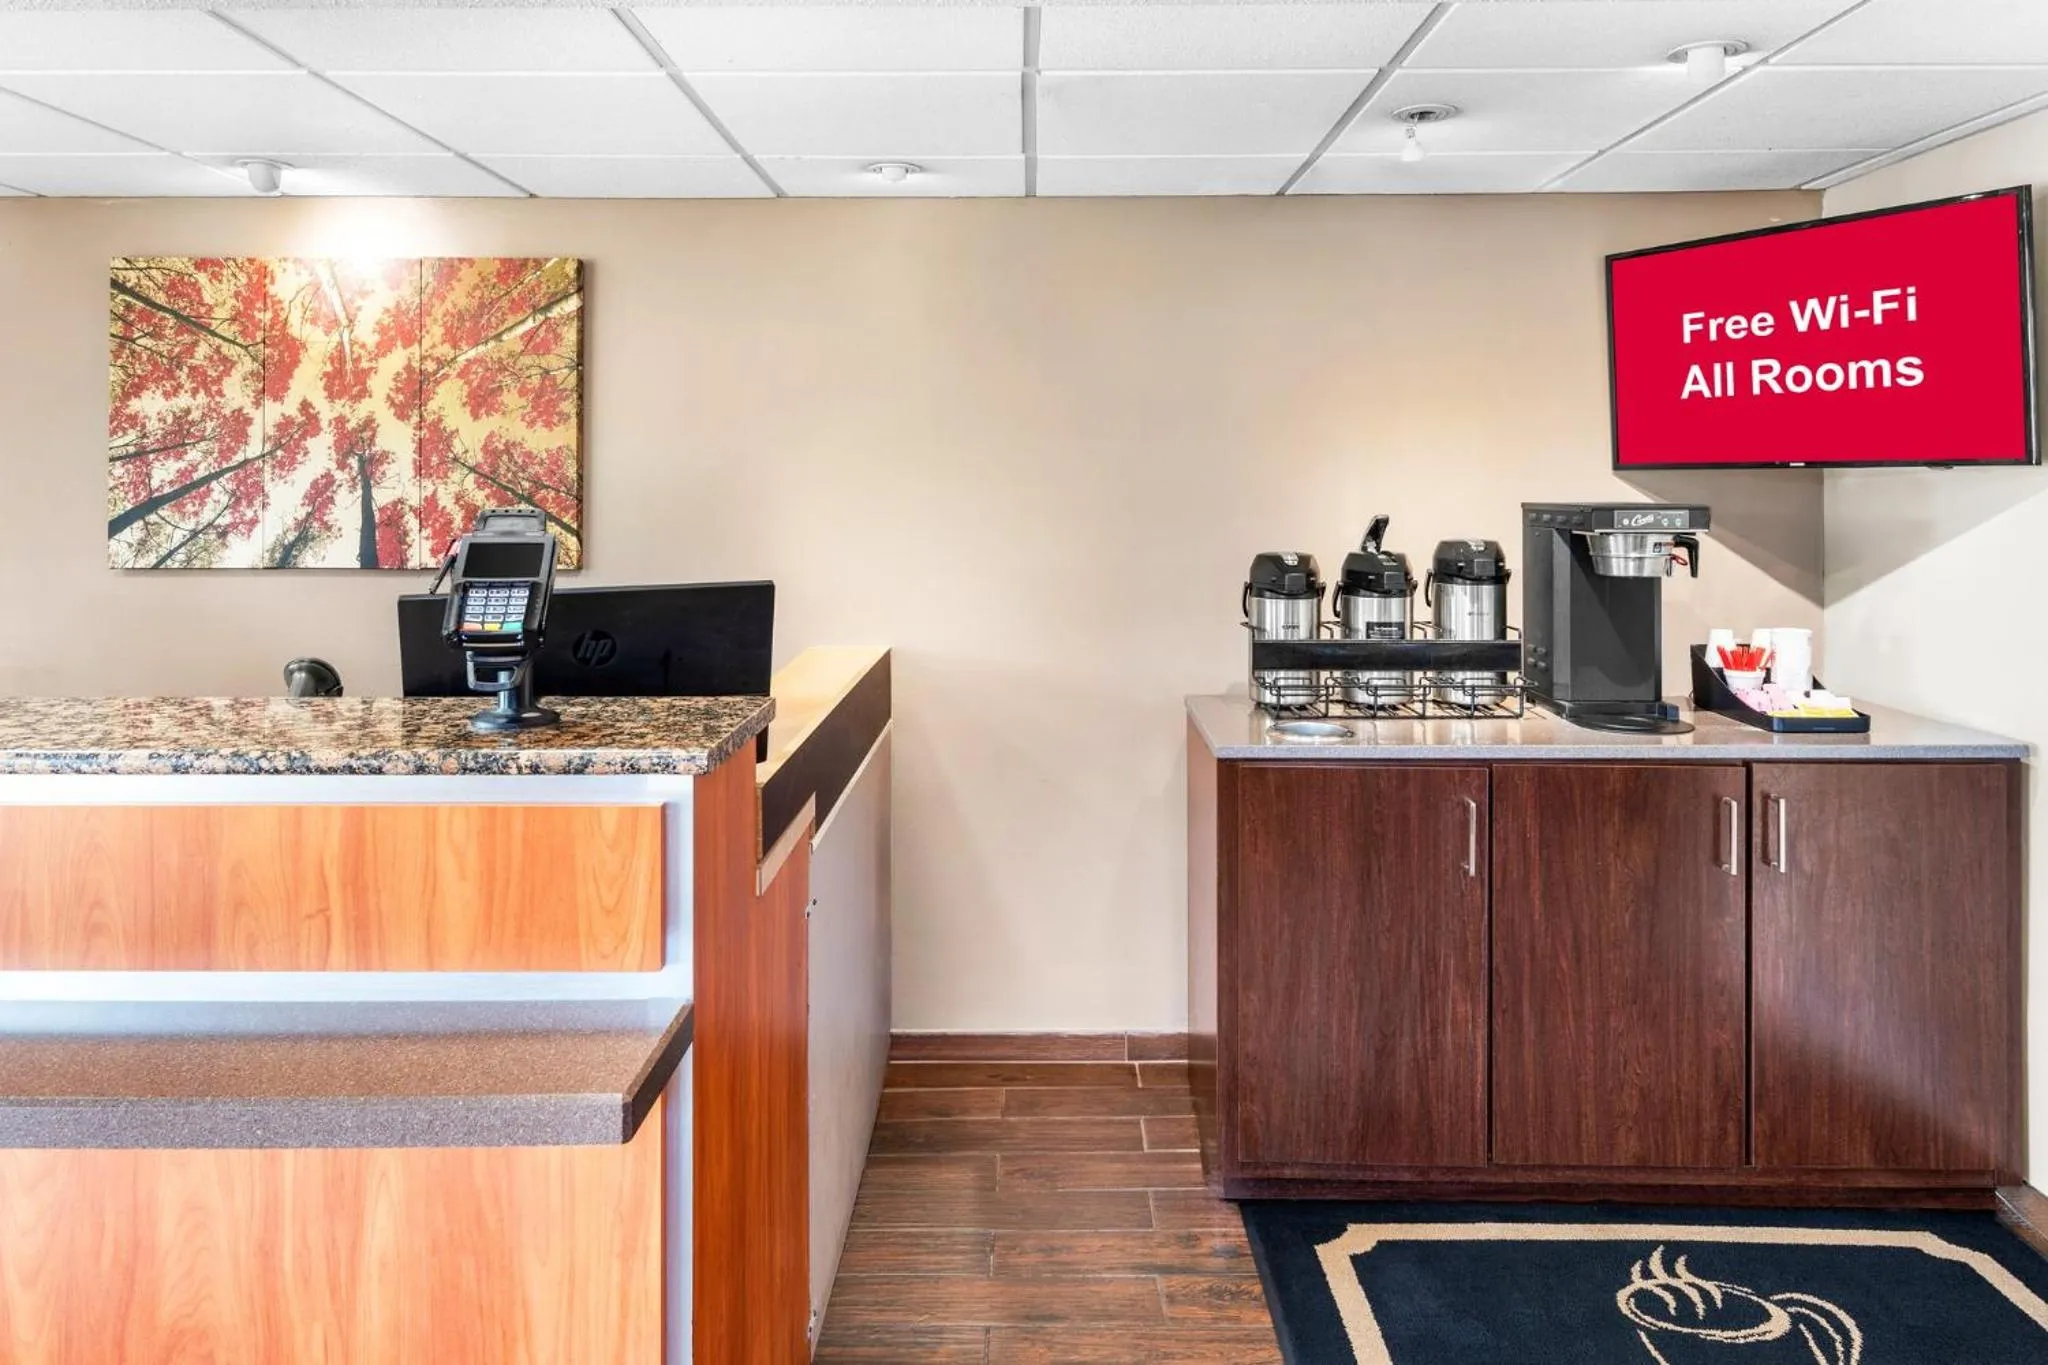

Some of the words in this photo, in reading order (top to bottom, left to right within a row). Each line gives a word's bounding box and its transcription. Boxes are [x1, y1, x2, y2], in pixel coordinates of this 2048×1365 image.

[1682, 311, 1775, 344] Free
[1789, 286, 1917, 333] Wi-Fi
[1680, 361, 1735, 400] All
[1751, 356, 1925, 396] Rooms
[577, 631, 612, 667] hp
